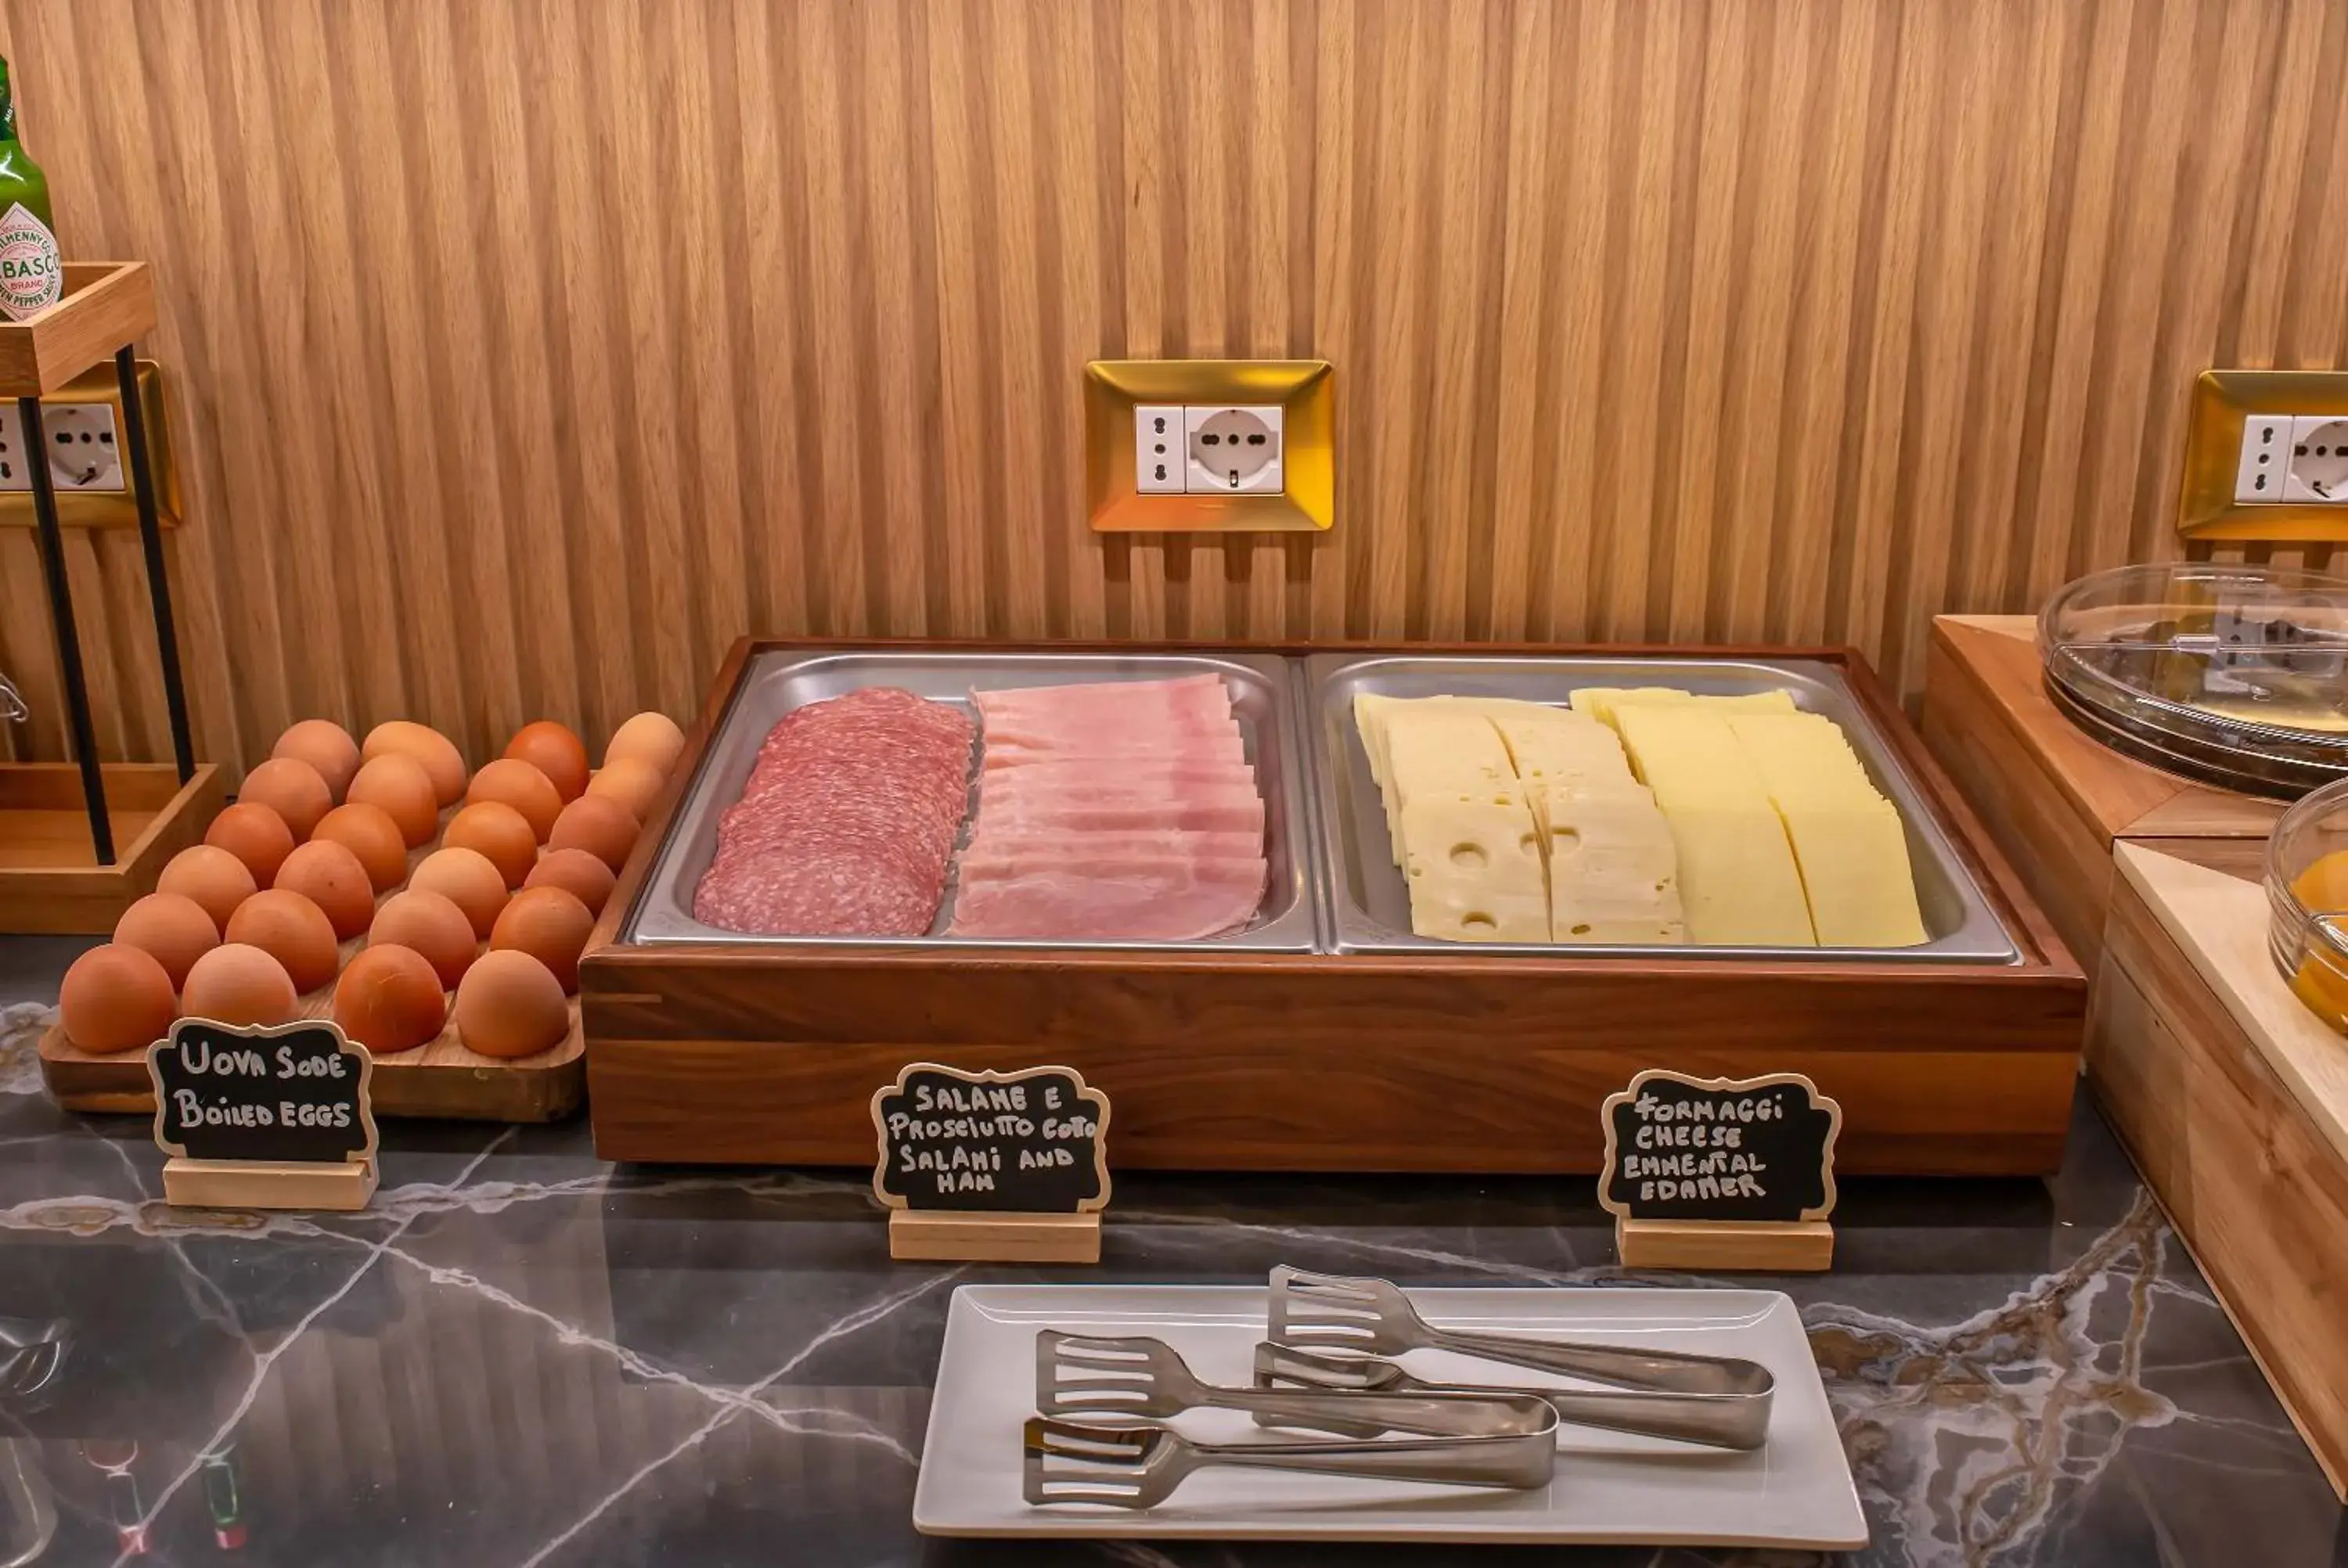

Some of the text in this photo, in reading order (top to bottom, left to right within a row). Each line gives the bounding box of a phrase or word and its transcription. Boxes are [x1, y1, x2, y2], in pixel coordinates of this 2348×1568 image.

[10, 279, 43, 290] BRAND
[916, 1085, 1062, 1113] SALAME E
[279, 1101, 351, 1127] EGGS
[1635, 1124, 1741, 1149] CHEESE
[1019, 1148, 1075, 1171] AND
[1624, 1151, 1766, 1179] EMMENTAL
[937, 1171, 995, 1193] HAM
[1640, 1174, 1766, 1201] EDAMER
